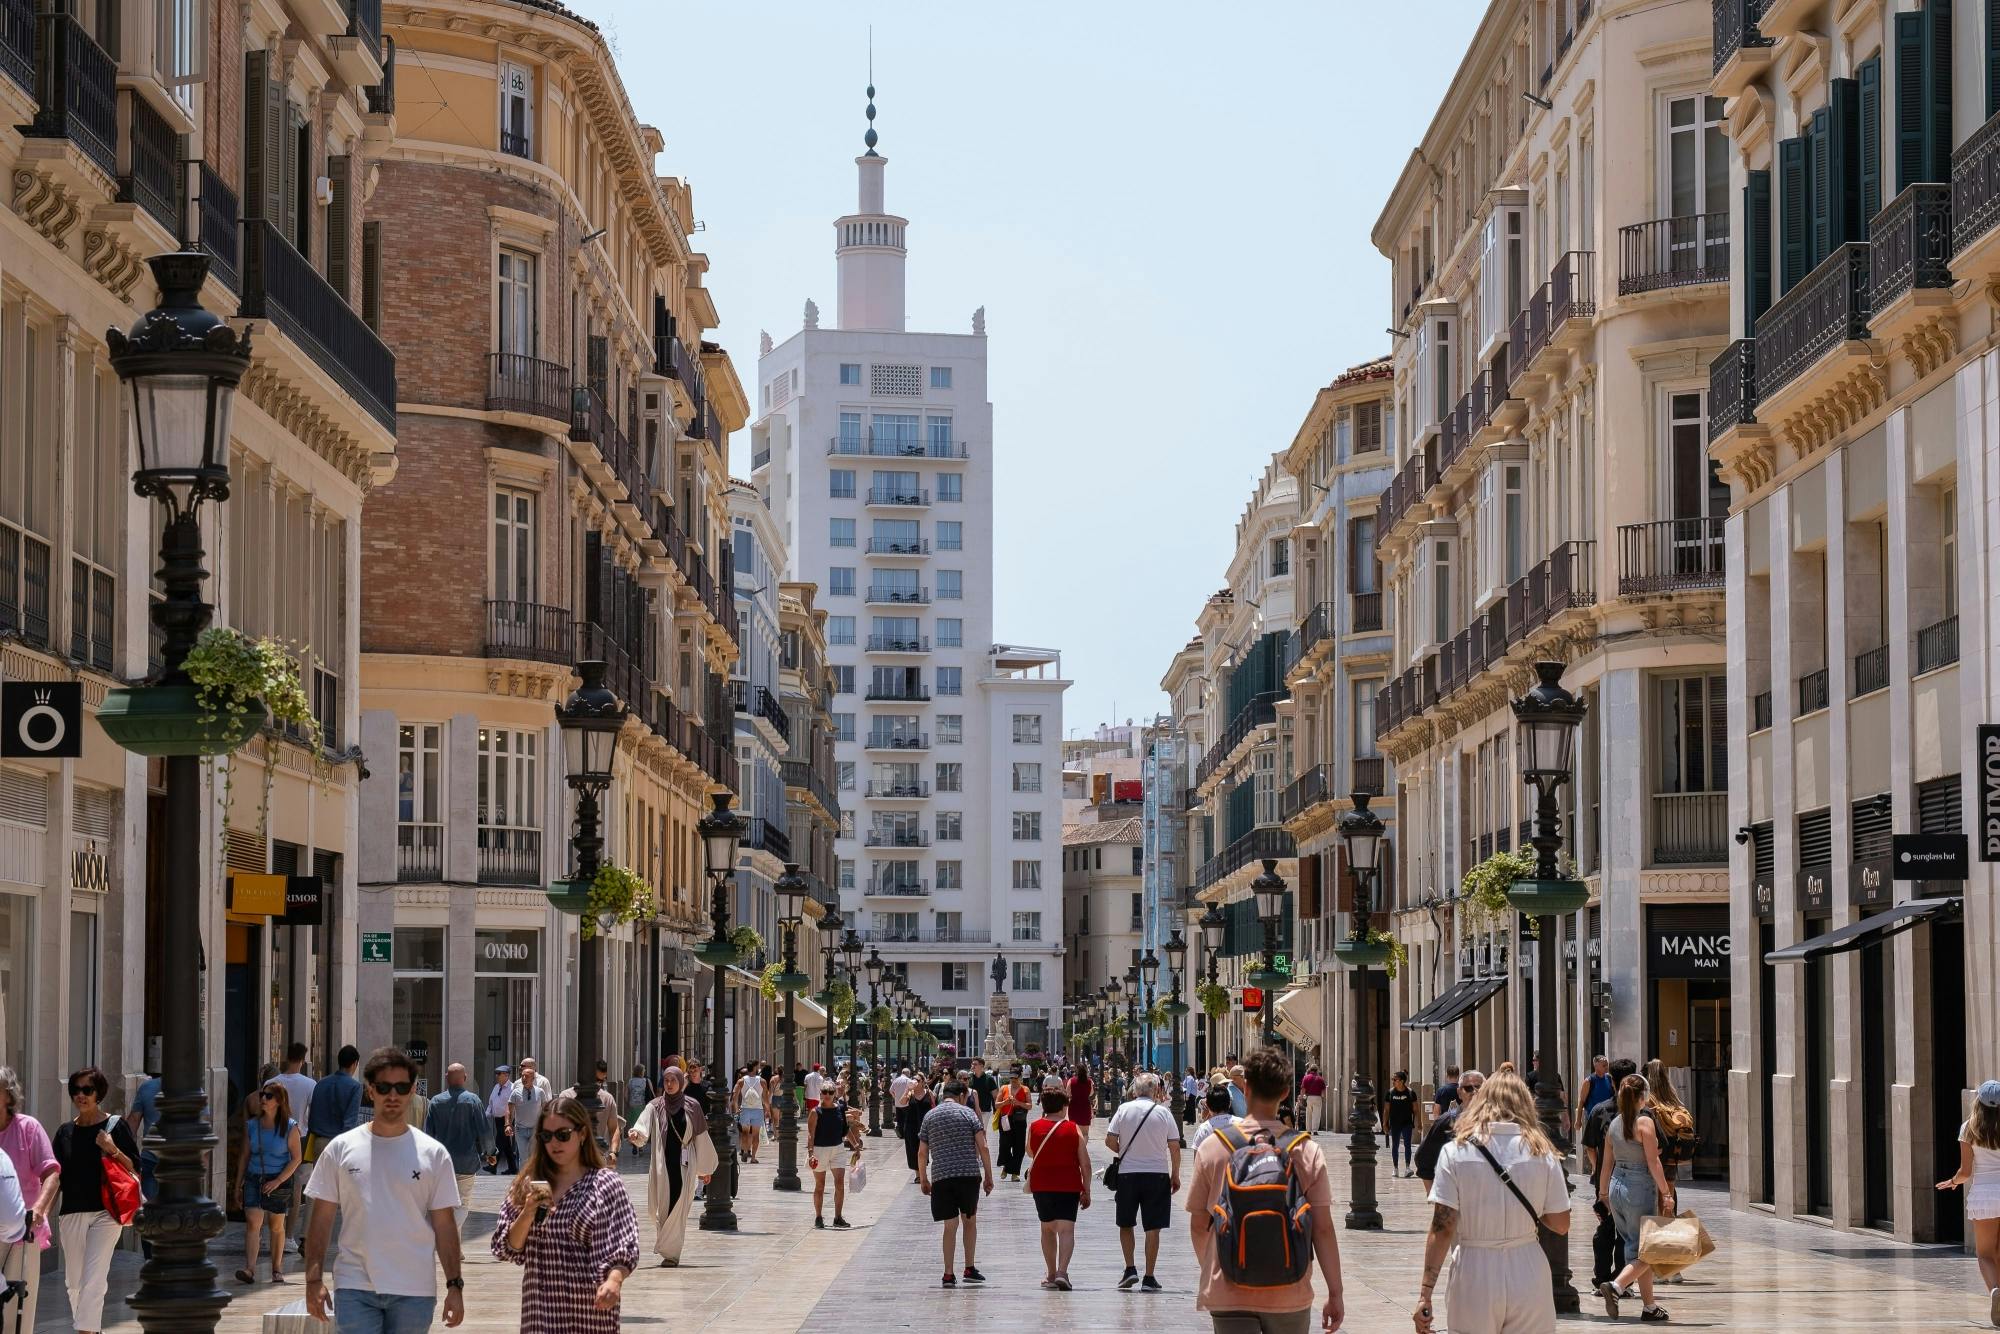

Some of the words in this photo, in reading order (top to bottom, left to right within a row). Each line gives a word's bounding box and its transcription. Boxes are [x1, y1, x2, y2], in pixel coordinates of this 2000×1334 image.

[1912, 852, 1943, 863] sunglass
[1944, 852, 1956, 861] hut
[485, 942, 529, 960] OYSHO
[1694, 958, 1719, 968] MAN
